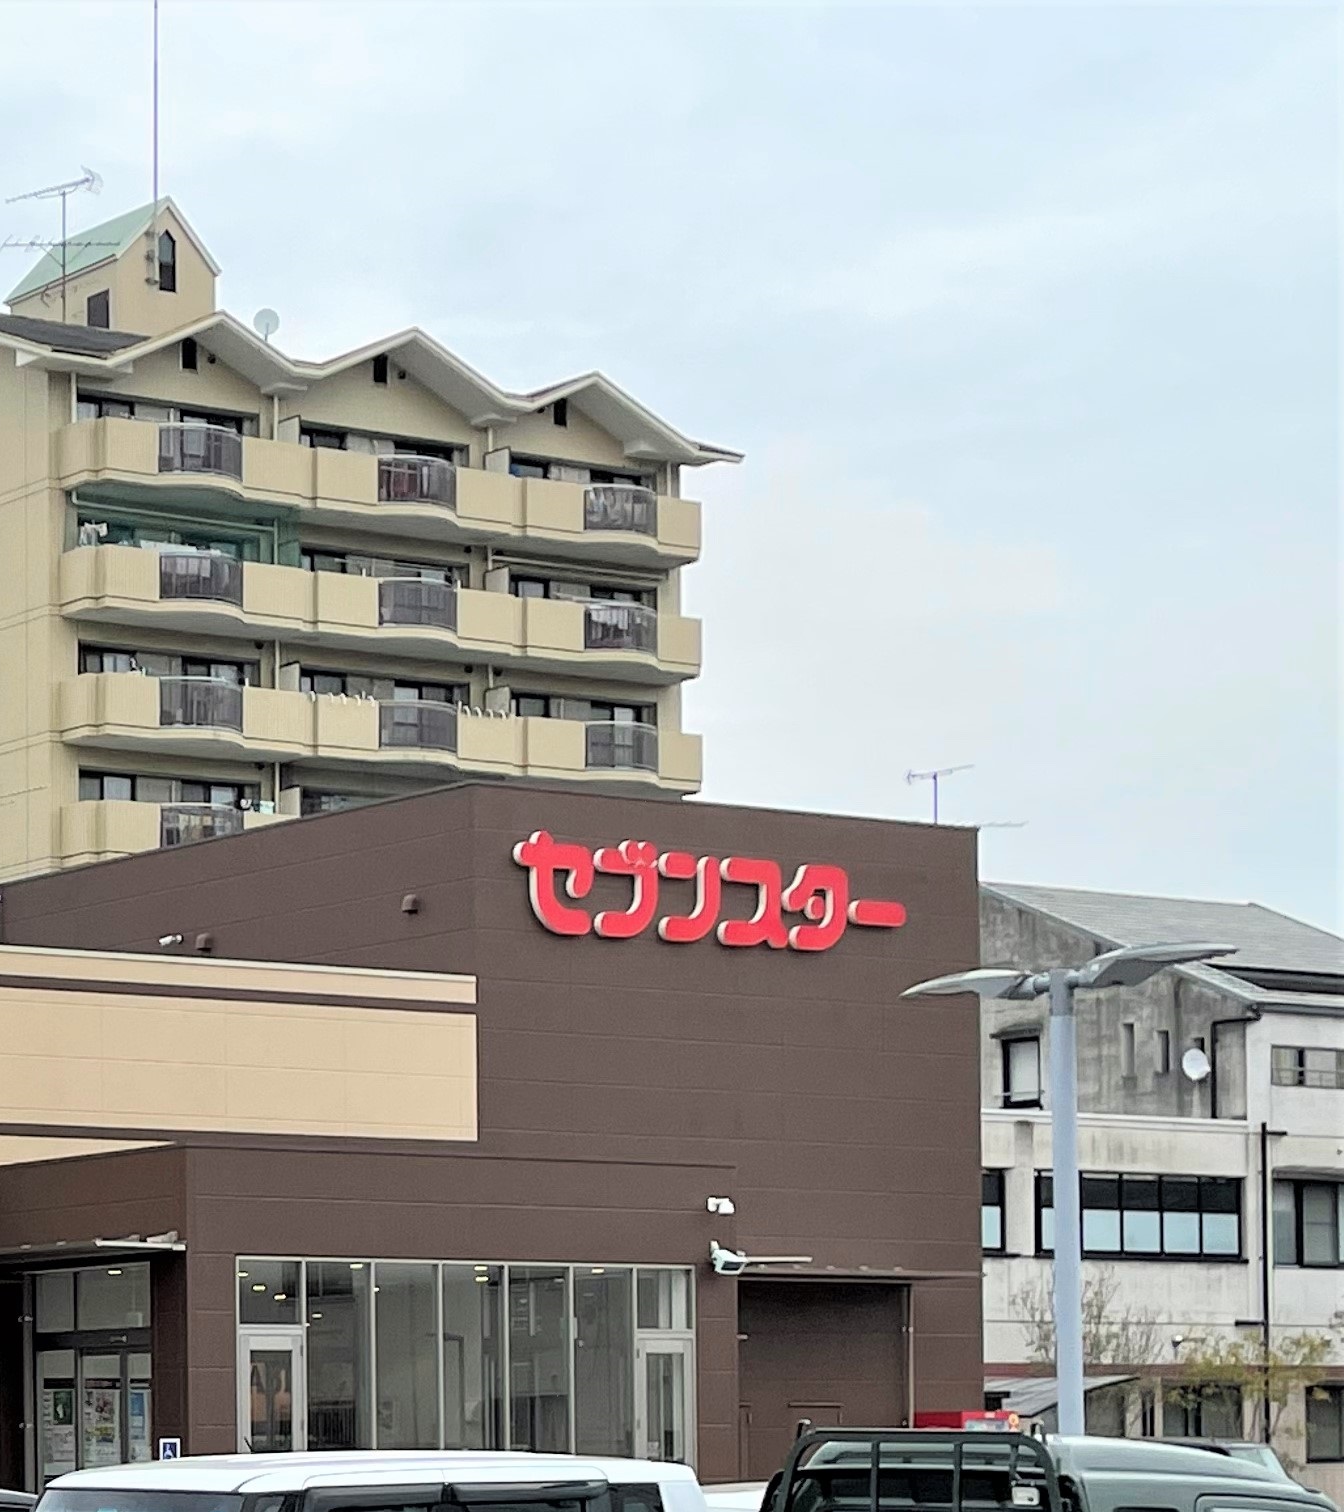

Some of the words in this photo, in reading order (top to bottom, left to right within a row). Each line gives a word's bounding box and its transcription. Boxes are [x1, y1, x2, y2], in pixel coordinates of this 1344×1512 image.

[513, 830, 906, 951] セブンスター
